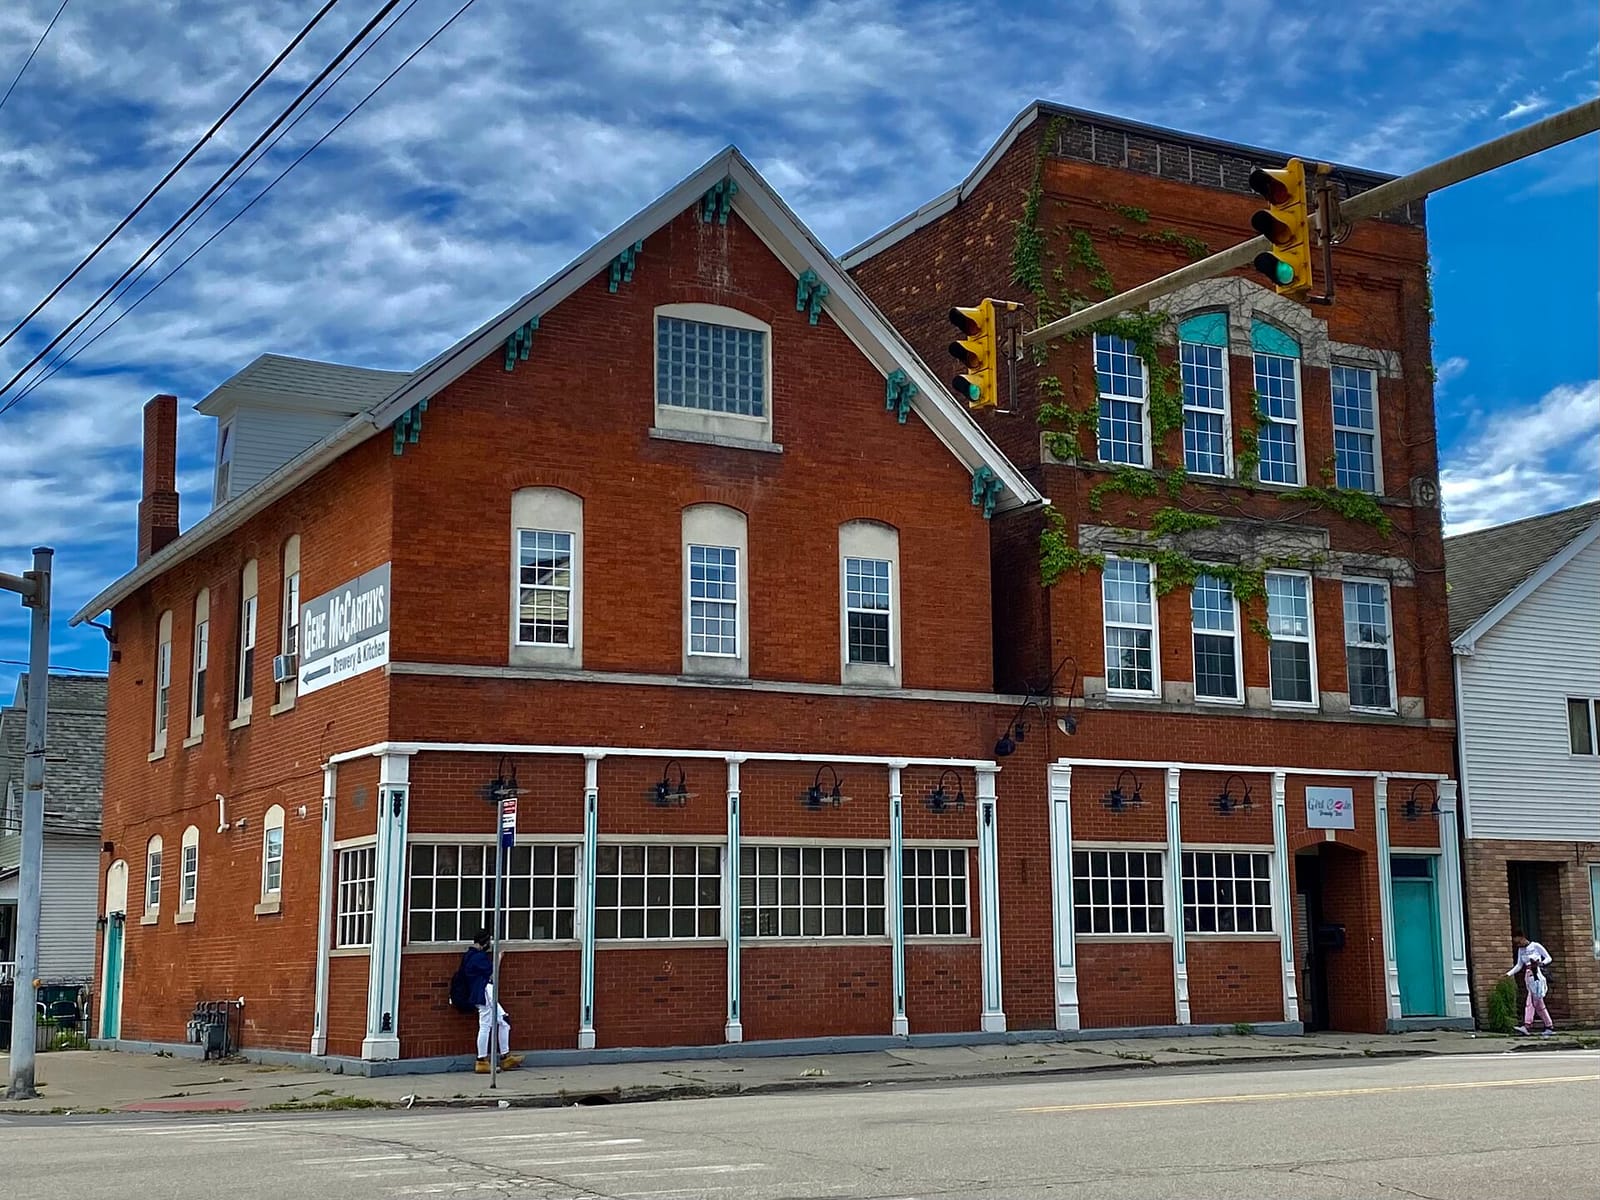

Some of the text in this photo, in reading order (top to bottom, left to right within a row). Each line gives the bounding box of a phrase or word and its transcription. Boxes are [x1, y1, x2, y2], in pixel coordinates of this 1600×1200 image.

[305, 609, 326, 659] GENE
[333, 639, 385, 674] Brewery & Kitchen
